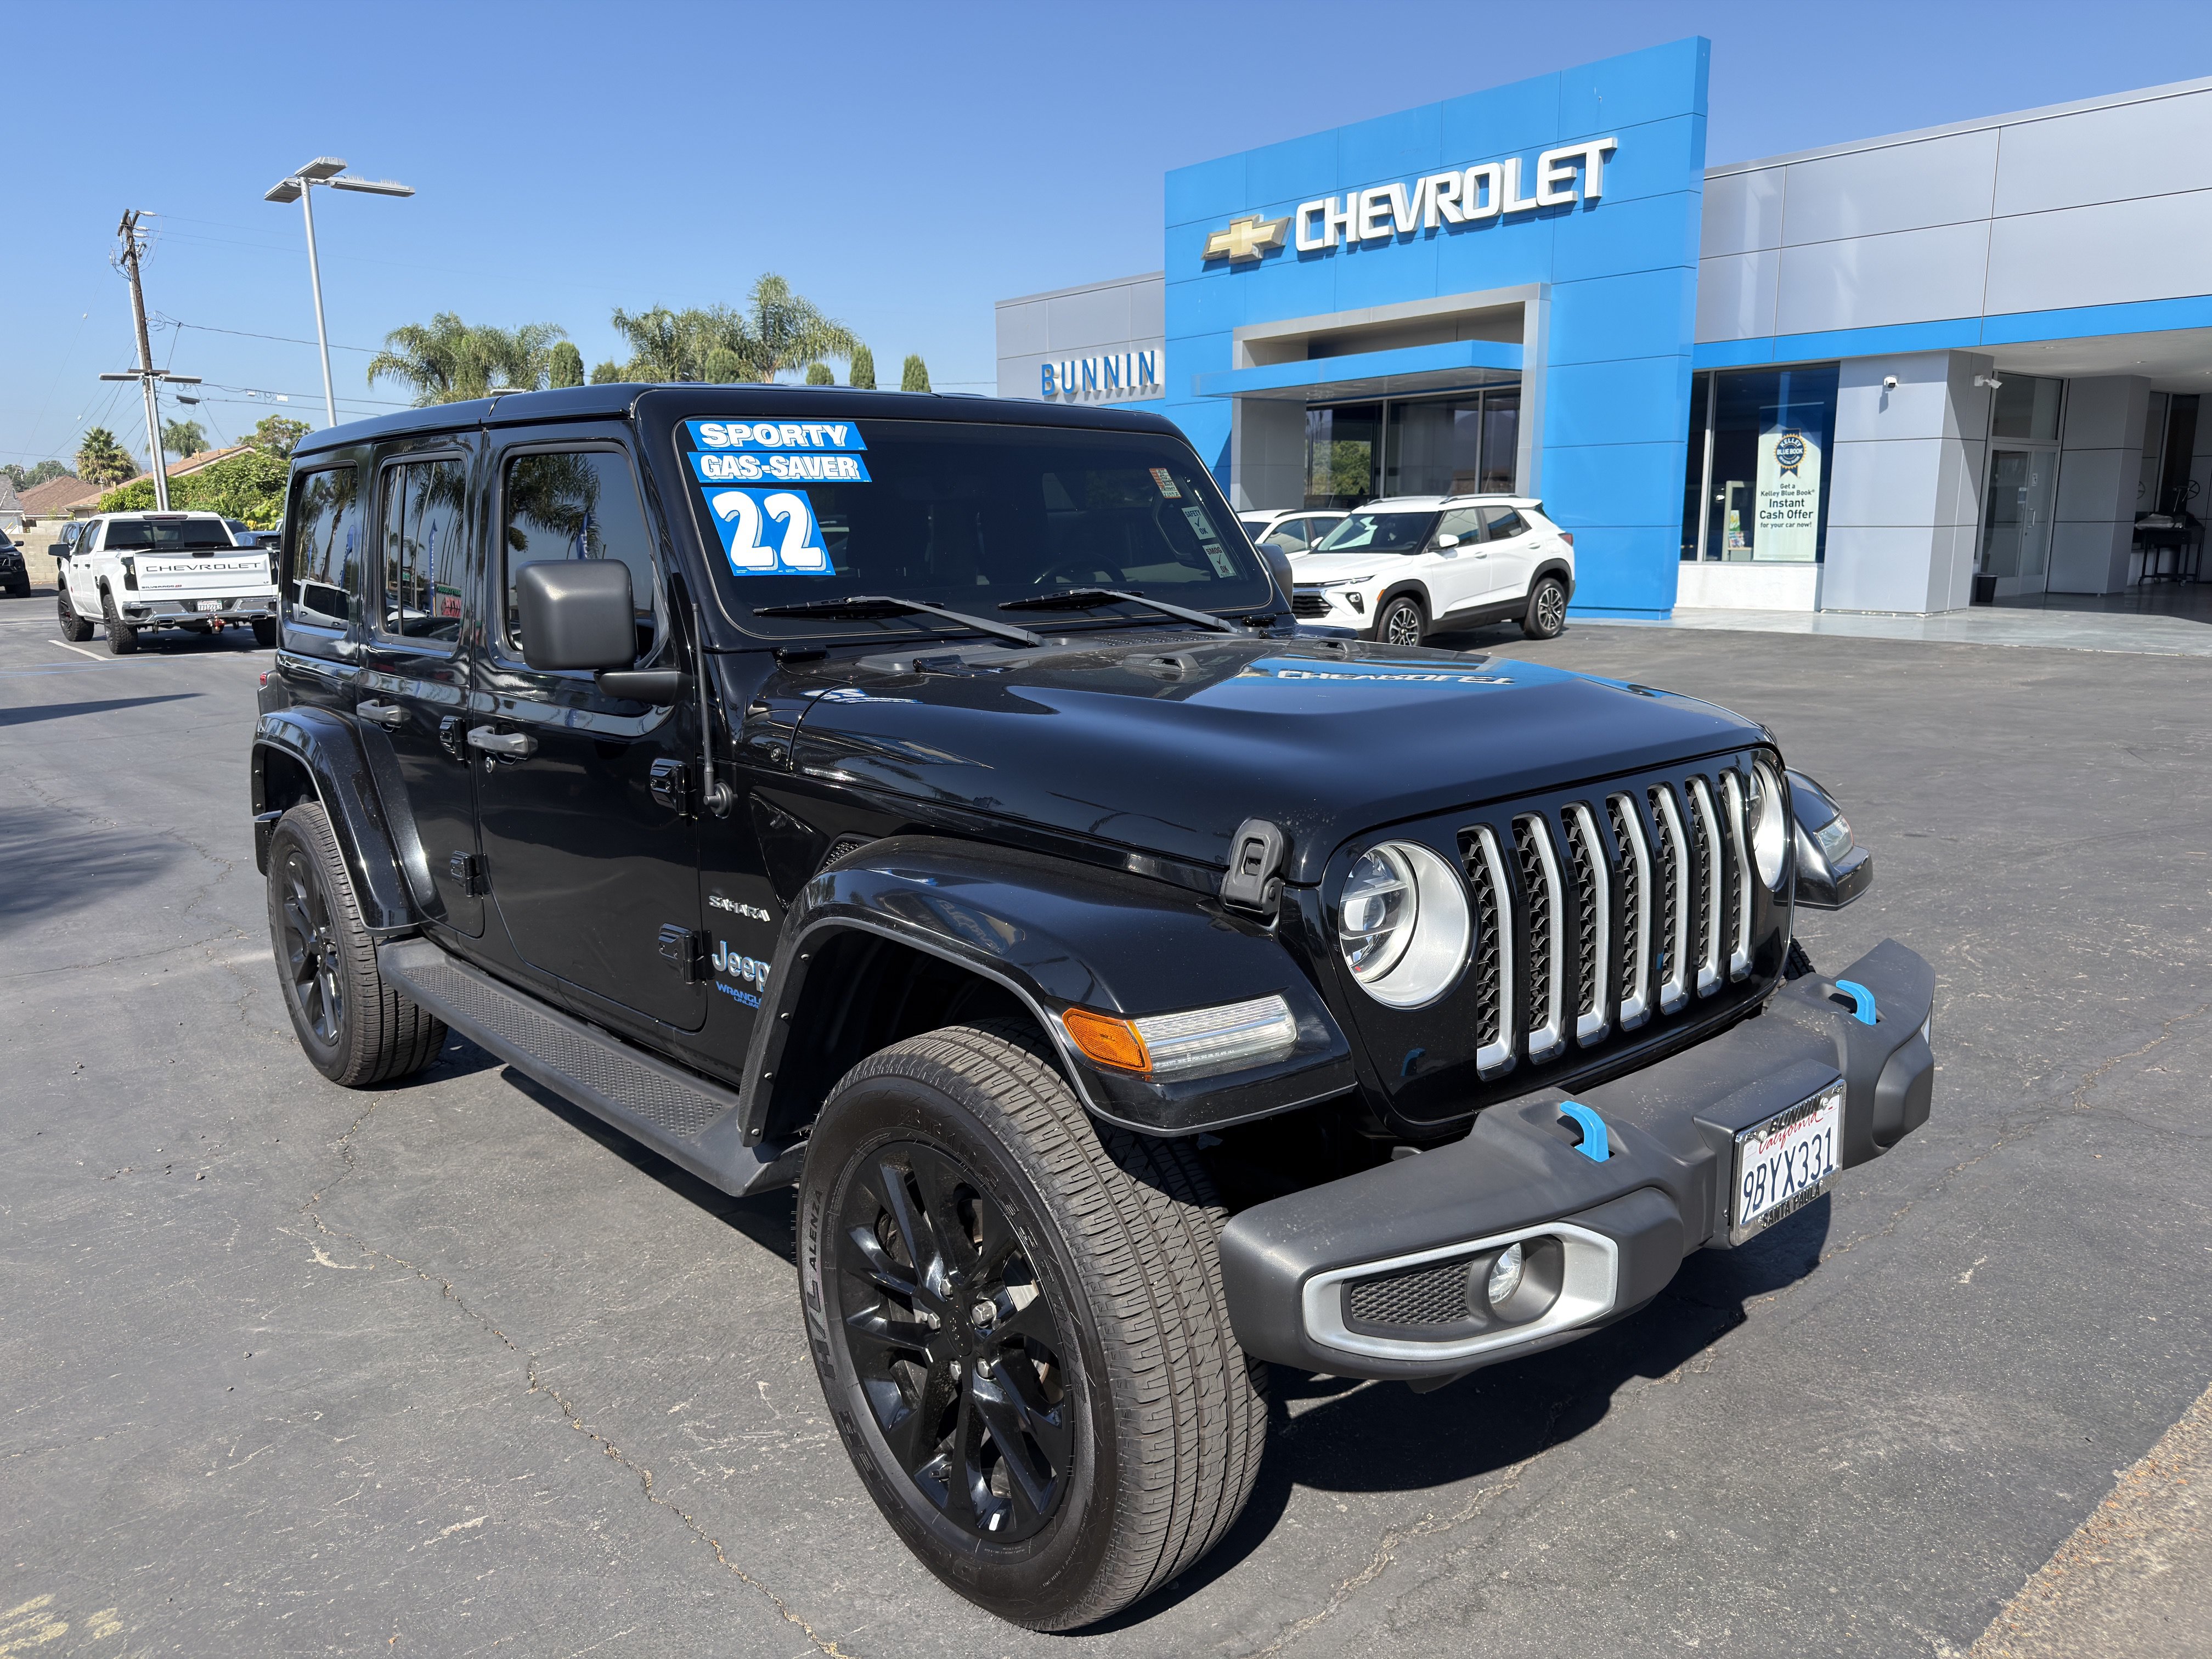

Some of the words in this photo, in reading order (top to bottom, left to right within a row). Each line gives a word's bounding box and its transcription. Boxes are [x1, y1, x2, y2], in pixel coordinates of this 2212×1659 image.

[1296, 137, 1617, 251] CHEVROLET
[1041, 350, 1156, 396] BUNNIN
[699, 423, 848, 447] SPORTY
[1780, 438, 1802, 447] KELLEY
[701, 455, 861, 479] GAS-SAVER
[1759, 510, 1784, 519] Cash
[1787, 510, 1813, 519] Offer
[1769, 498, 1805, 507] Instant
[712, 491, 826, 571] 22
[146, 562, 261, 572] CHEVROLET
[709, 895, 771, 922] SAHARA
[712, 940, 771, 992] Jeep
[1759, 1111, 1824, 1154] California
[1768, 1093, 1821, 1136] BUNNIN
[1741, 1127, 1833, 1224] 9BYX331
[1762, 1198, 1791, 1229] SANTA
[1793, 1181, 1821, 1207] PAULA
[809, 1189, 823, 1272] ALENZA
